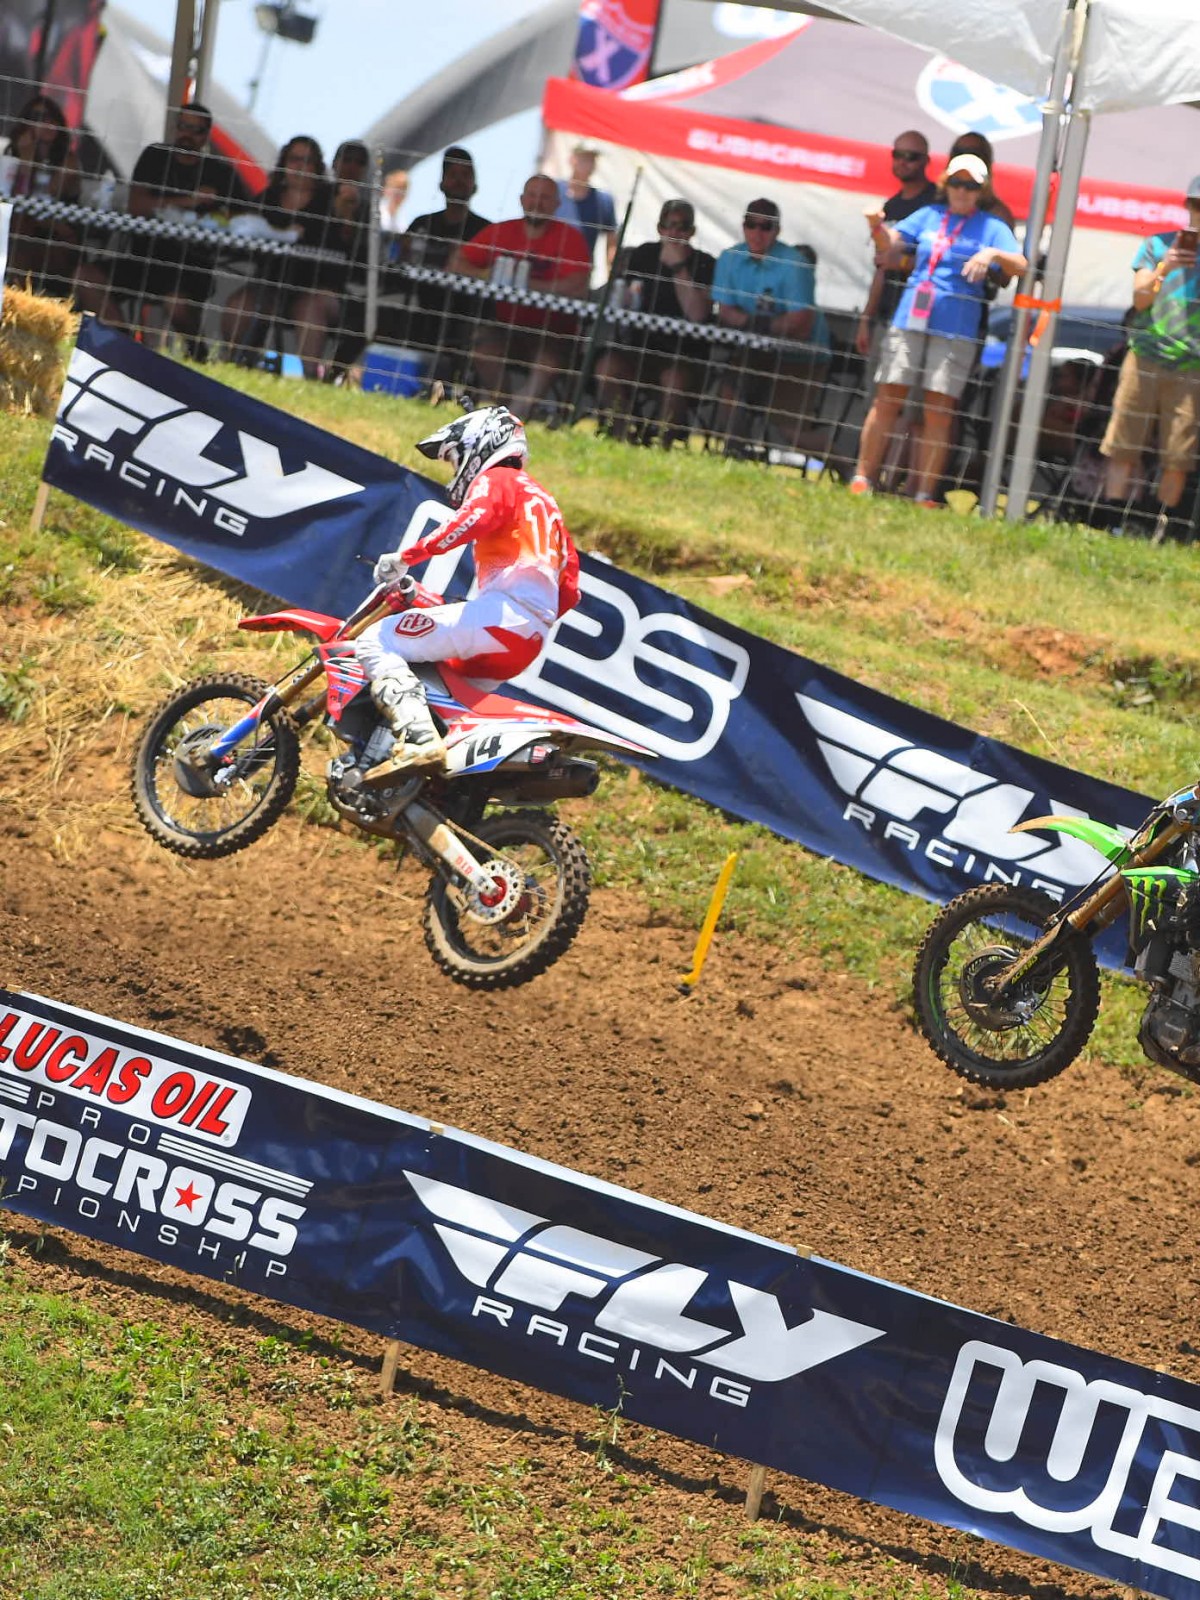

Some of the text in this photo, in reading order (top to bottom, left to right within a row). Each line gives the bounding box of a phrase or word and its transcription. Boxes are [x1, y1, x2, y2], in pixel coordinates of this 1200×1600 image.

[50, 423, 249, 537] RACING
[438, 508, 487, 549] HONDA
[465, 735, 503, 767] 14
[0, 1013, 238, 1137] LUCAS OIL
[37, 1090, 151, 1145] PRO
[0, 1105, 307, 1257] TOCROSS
[17, 1174, 288, 1278] PIONSHIP
[402, 1169, 887, 1383] FLY
[471, 1295, 752, 1408] RACING
